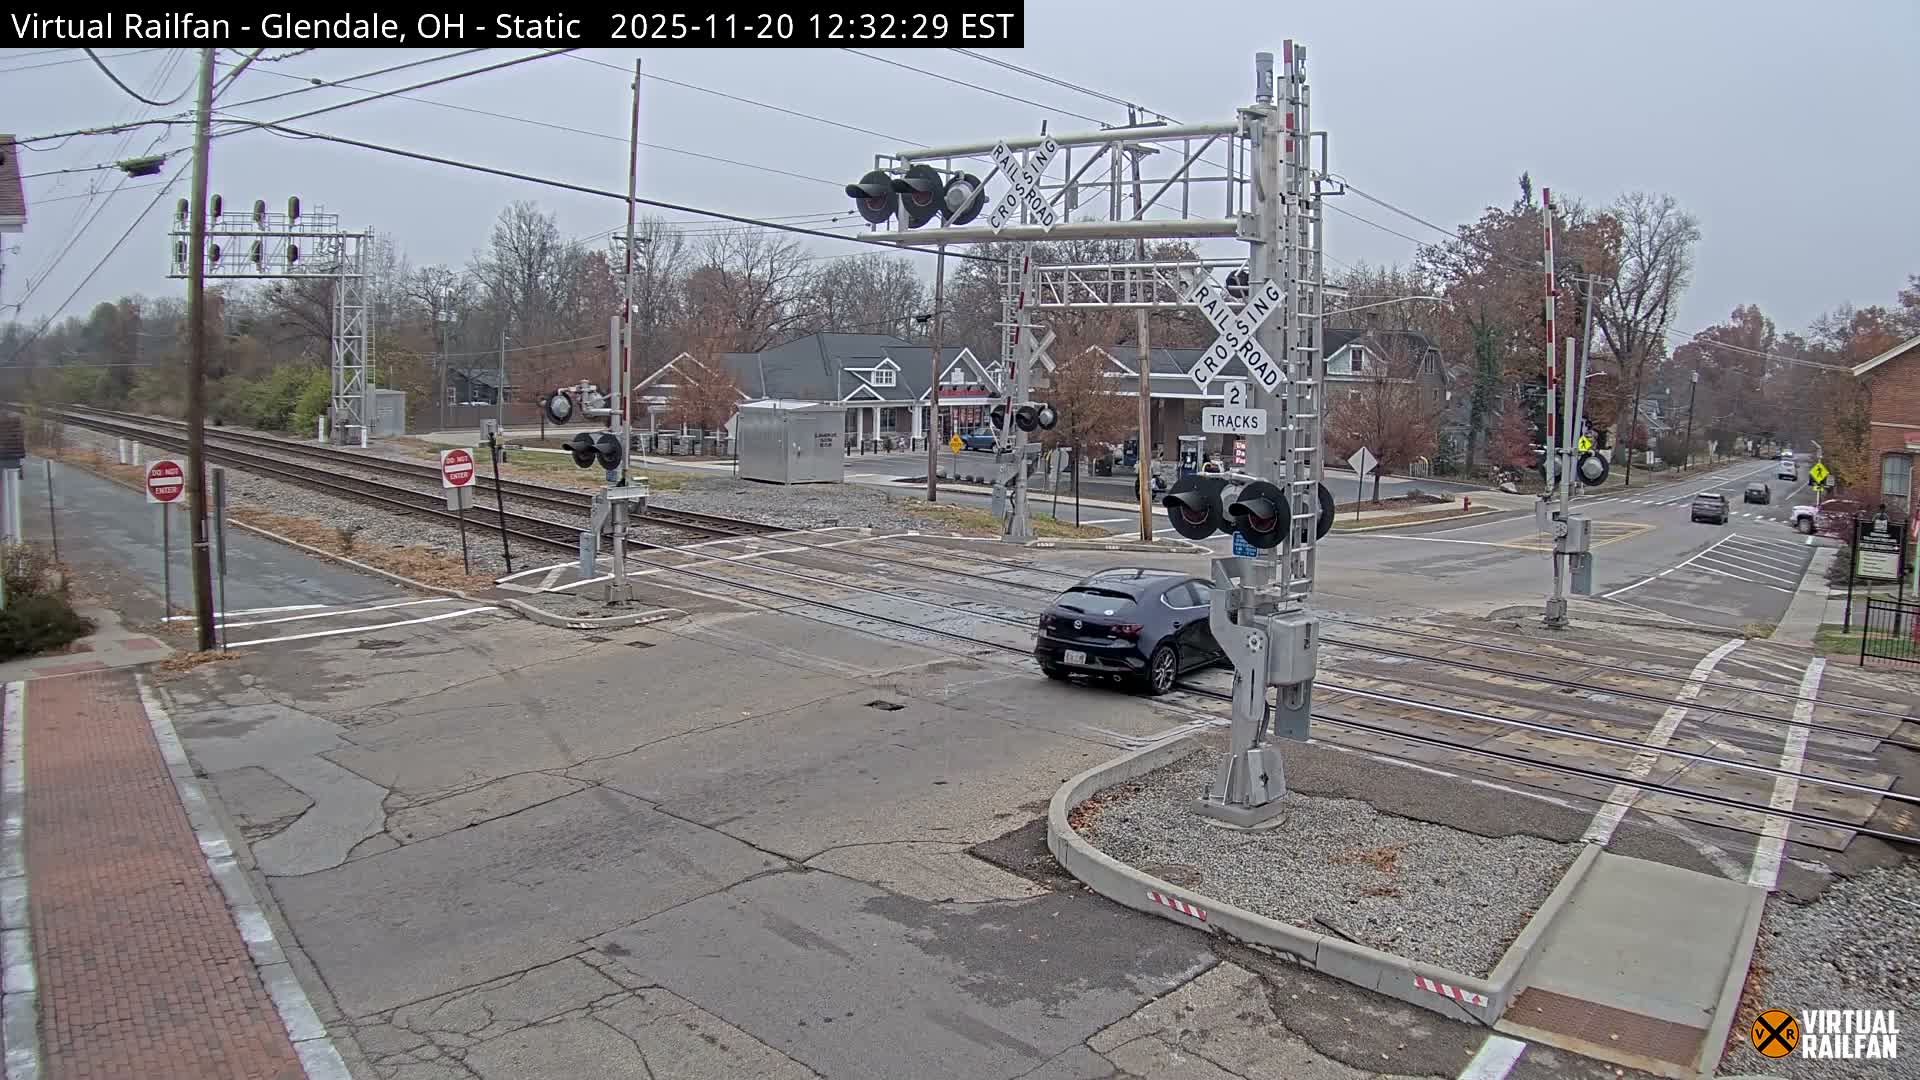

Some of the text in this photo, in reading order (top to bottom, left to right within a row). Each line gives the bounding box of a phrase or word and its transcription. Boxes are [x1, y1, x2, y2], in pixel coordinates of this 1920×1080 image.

[990, 140, 1055, 228] CROSSING
[1194, 286, 1280, 383] CROSSING
[1230, 387, 1240, 404] 2
[1210, 414, 1258, 429] TRACKS
[450, 472, 469, 480] ENTER
[155, 487, 177, 495] ENTER
